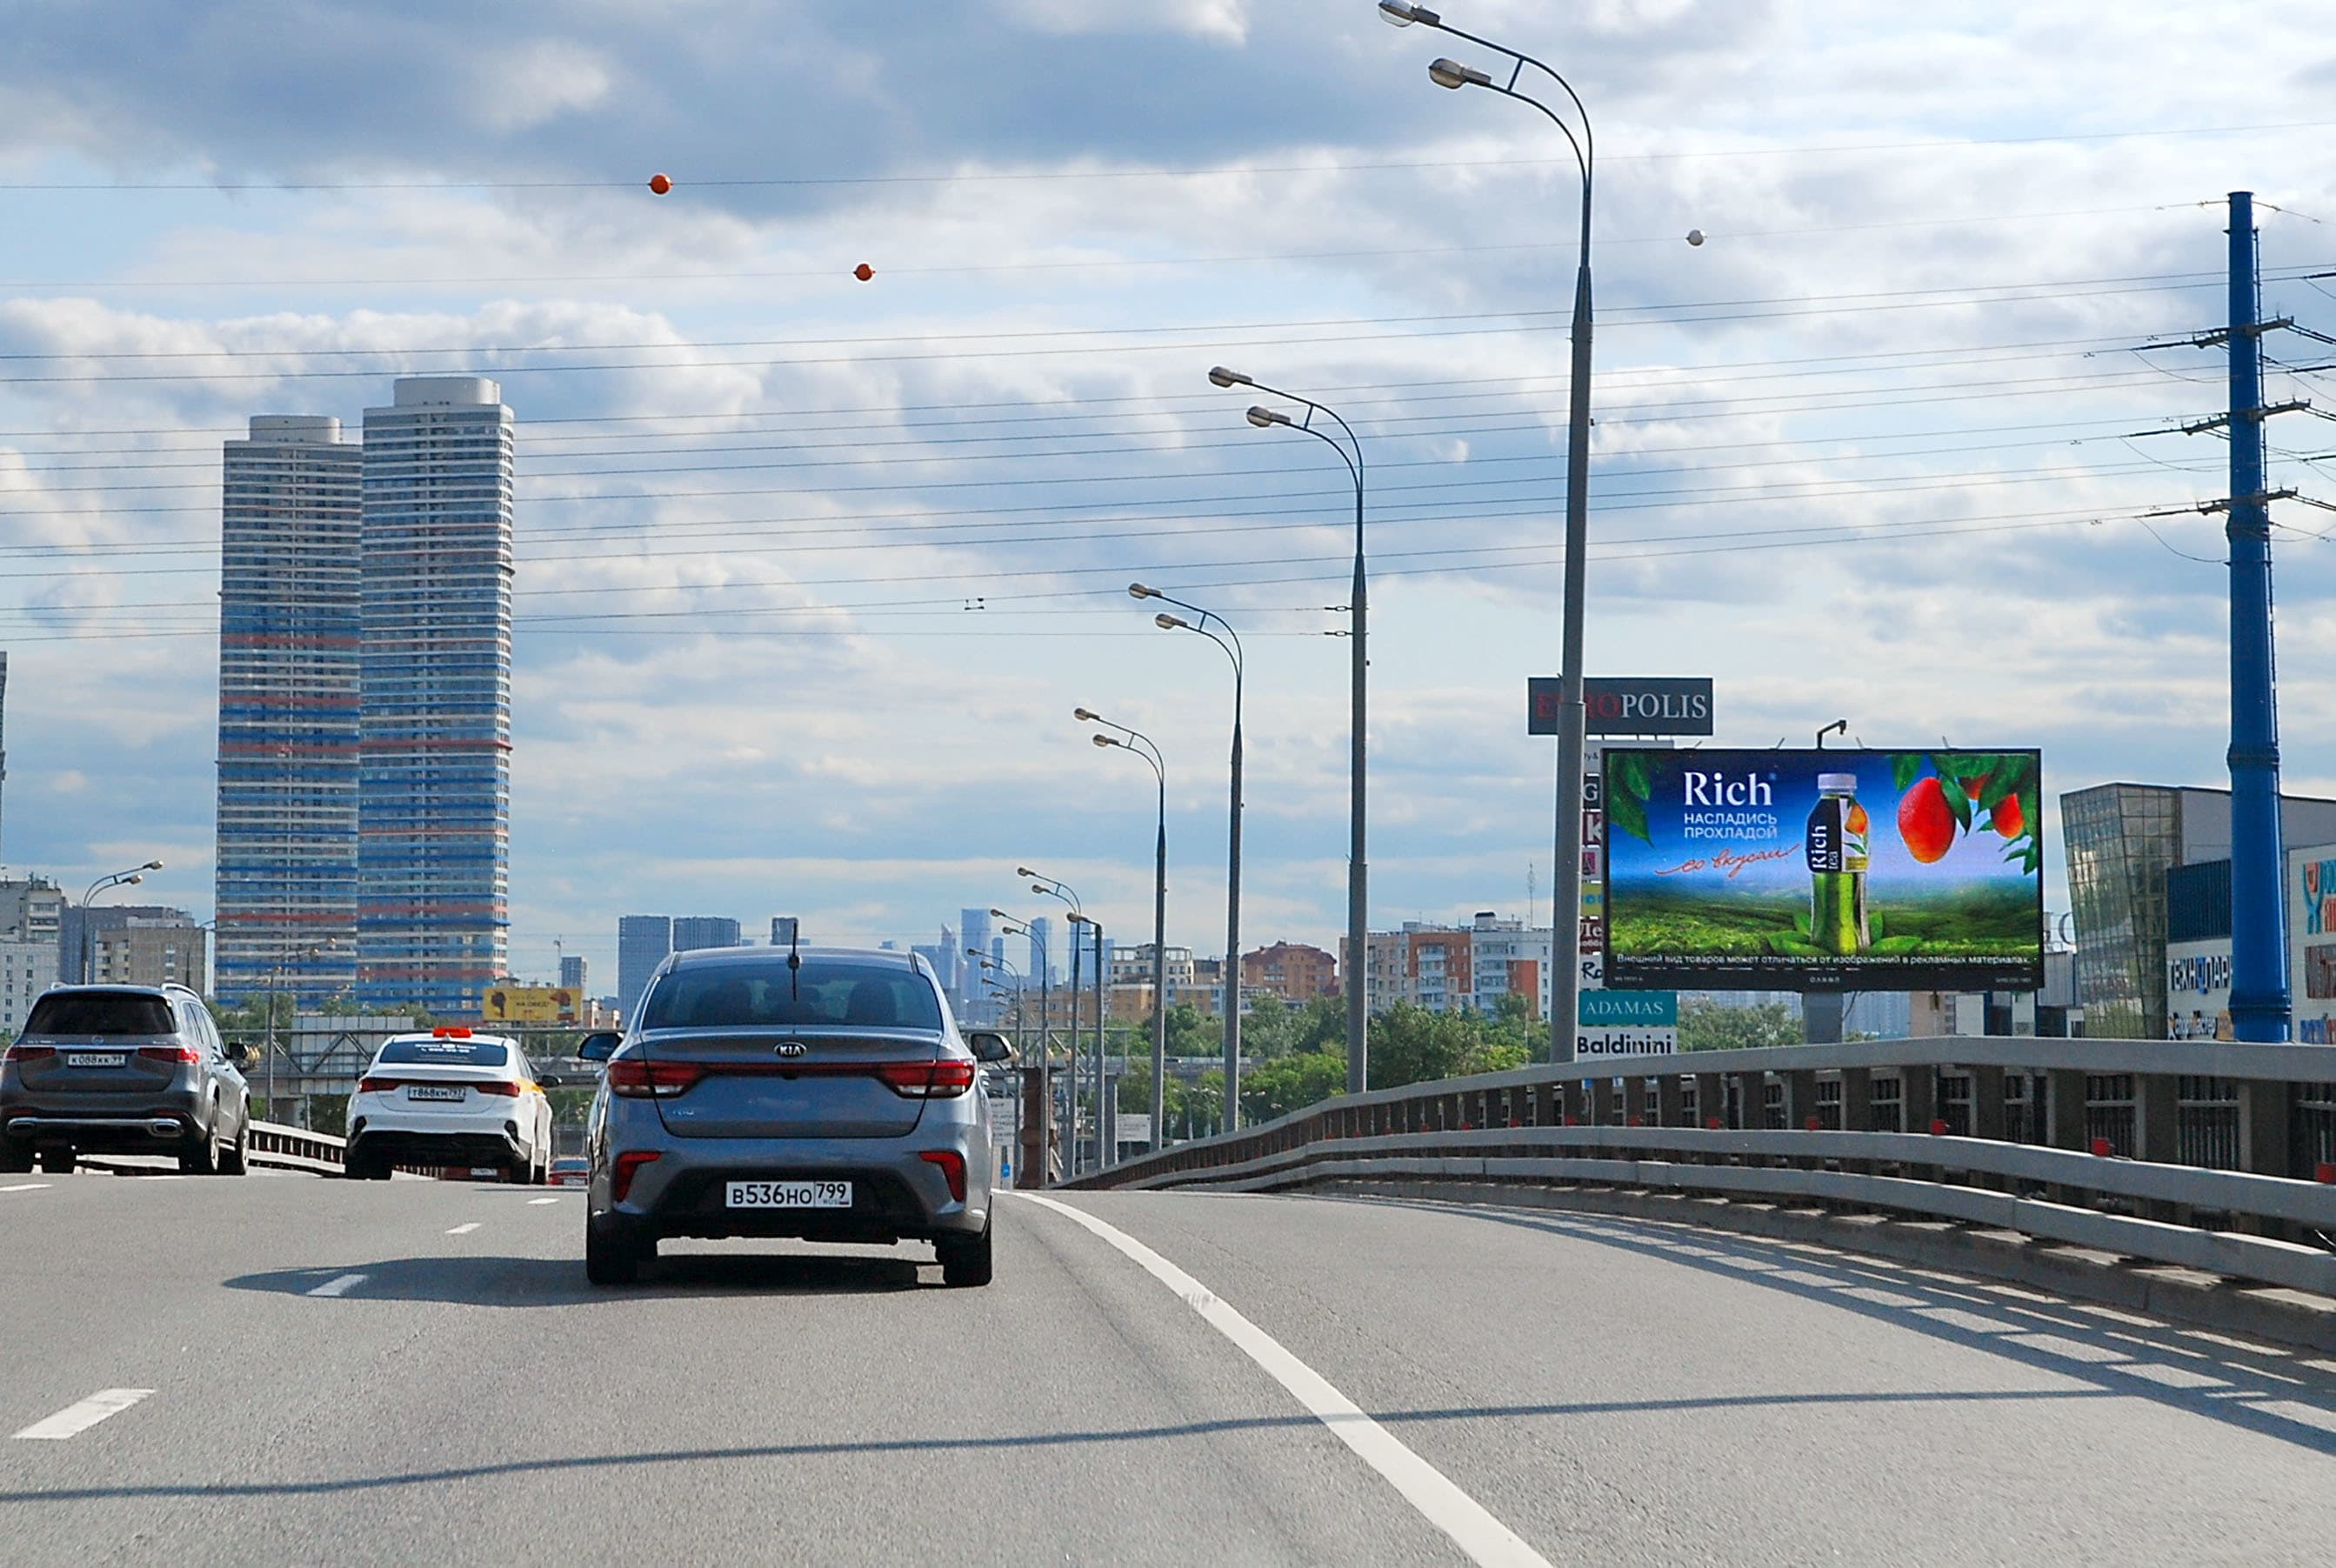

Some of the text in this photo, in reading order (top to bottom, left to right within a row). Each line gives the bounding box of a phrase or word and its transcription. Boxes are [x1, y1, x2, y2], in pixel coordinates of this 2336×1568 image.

[1536, 692, 1707, 719] EROPOLIS
[1684, 771, 1772, 806] Rich
[1684, 813, 1778, 825] НАСЛАДИСЬ
[1684, 826, 1778, 840] ПРОХЛАДОЙ
[1810, 825, 1827, 869] Rich
[1617, 953, 1662, 964] Внешний
[1665, 956, 1682, 965] вид
[1685, 956, 1724, 964] товаров
[1832, 954, 1900, 965] изображений
[1911, 956, 1966, 965] рекламных
[2167, 955, 2233, 995] ТЕХНОПАР
[1585, 1001, 1664, 1015] ADAMAS
[780, 1044, 801, 1056] KIA
[1578, 1033, 1672, 1054] Baldinini
